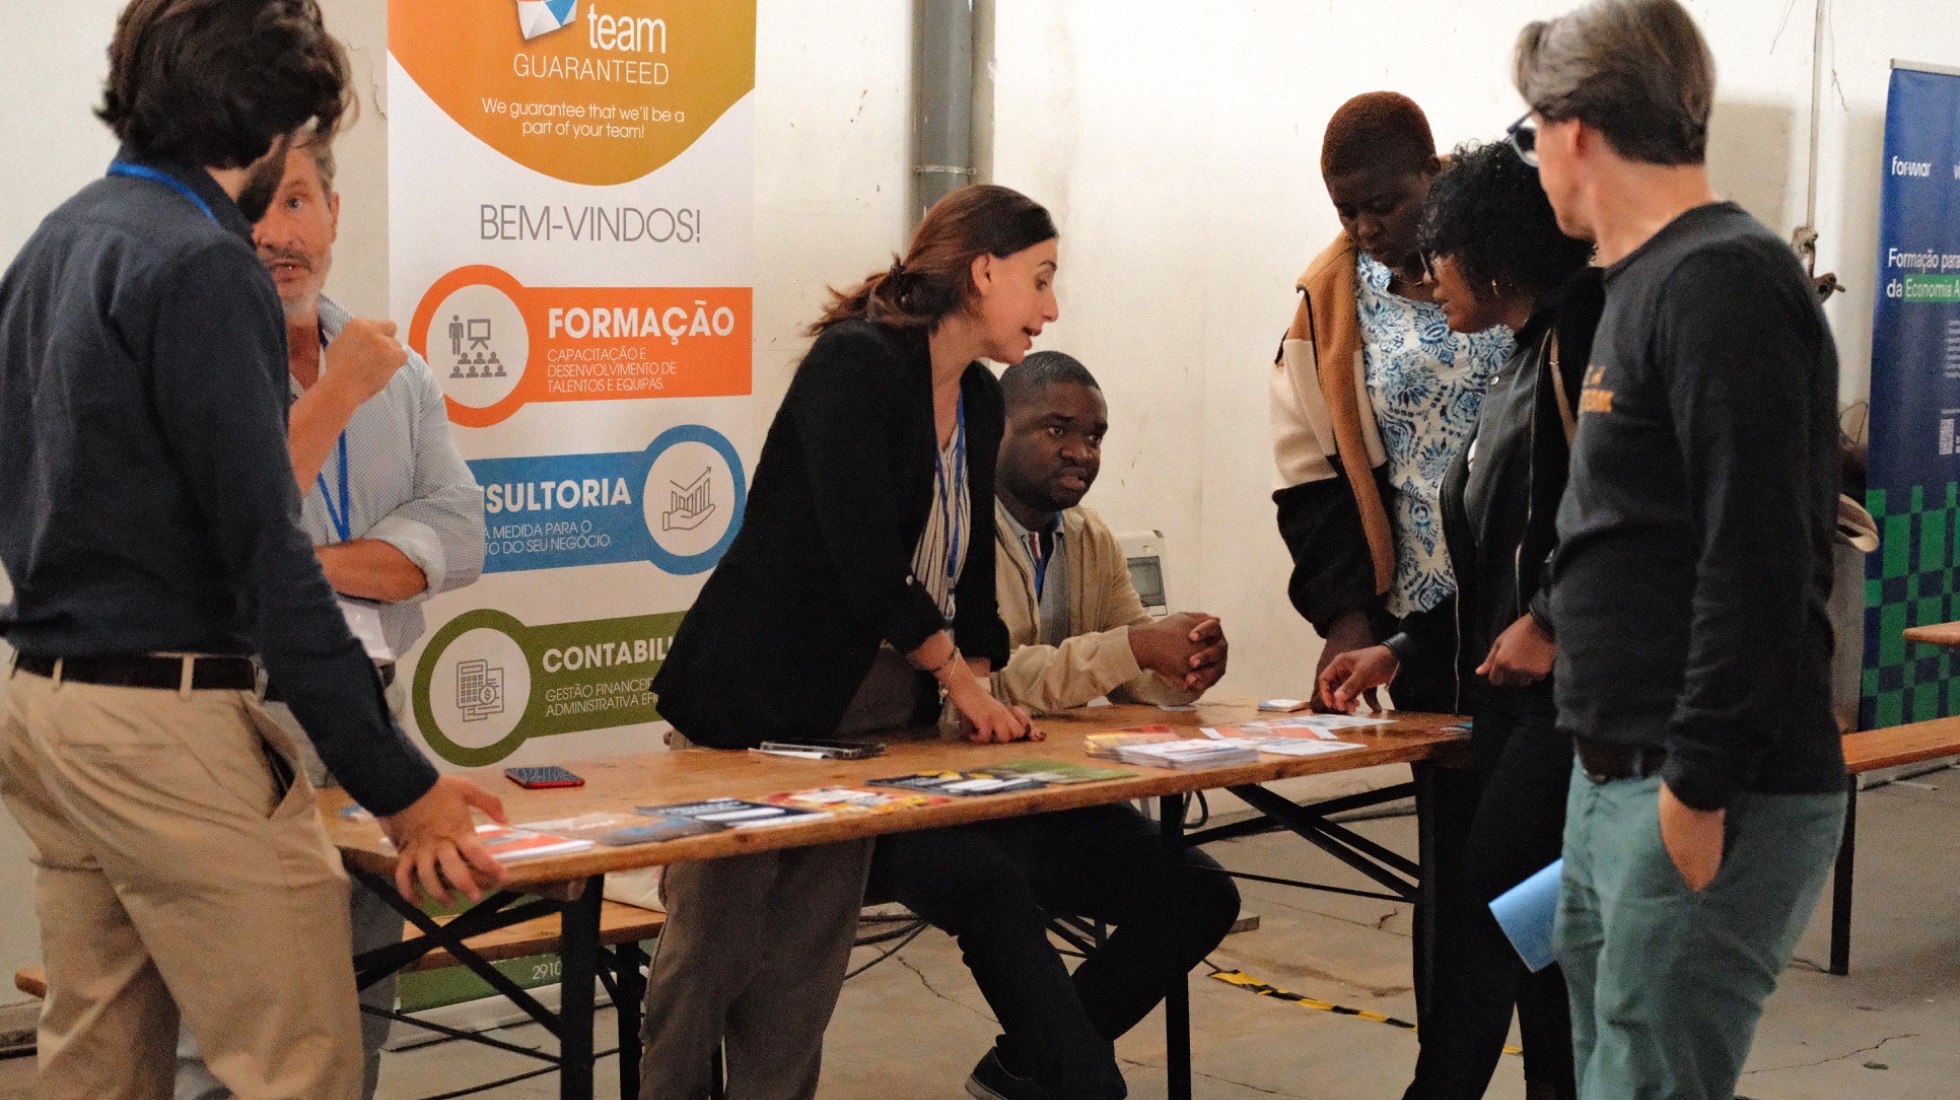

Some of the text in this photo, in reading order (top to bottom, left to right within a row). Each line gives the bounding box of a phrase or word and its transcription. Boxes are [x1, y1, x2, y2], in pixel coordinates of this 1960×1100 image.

[587, 3, 666, 54] team
[513, 53, 669, 85] GUARANTEED
[481, 97, 507, 114] We
[509, 101, 585, 119] guarantee
[589, 104, 616, 119] that
[652, 107, 671, 122] be
[674, 111, 685, 123] a
[522, 120, 645, 139] part of your team!
[480, 204, 701, 243] BEM-VINDOS!
[1888, 247, 1939, 274] Formação
[1886, 278, 1903, 298] da
[1905, 278, 1952, 298] Economia
[548, 300, 735, 345] FORMAÇÃO
[547, 345, 646, 363] CAPACITAÇÃO E
[547, 361, 677, 378] DESENVOLVIMENTO DE
[547, 378, 605, 393] TALENTOS
[607, 378, 613, 392] E
[493, 523, 543, 539] MEDIDA
[545, 521, 578, 535] PARA
[581, 519, 592, 533] O
[503, 540, 524, 554] DO
[527, 538, 548, 553] SEU
[545, 683, 593, 702] GESTÃO
[545, 695, 639, 717] ADMINISTRATIVA
